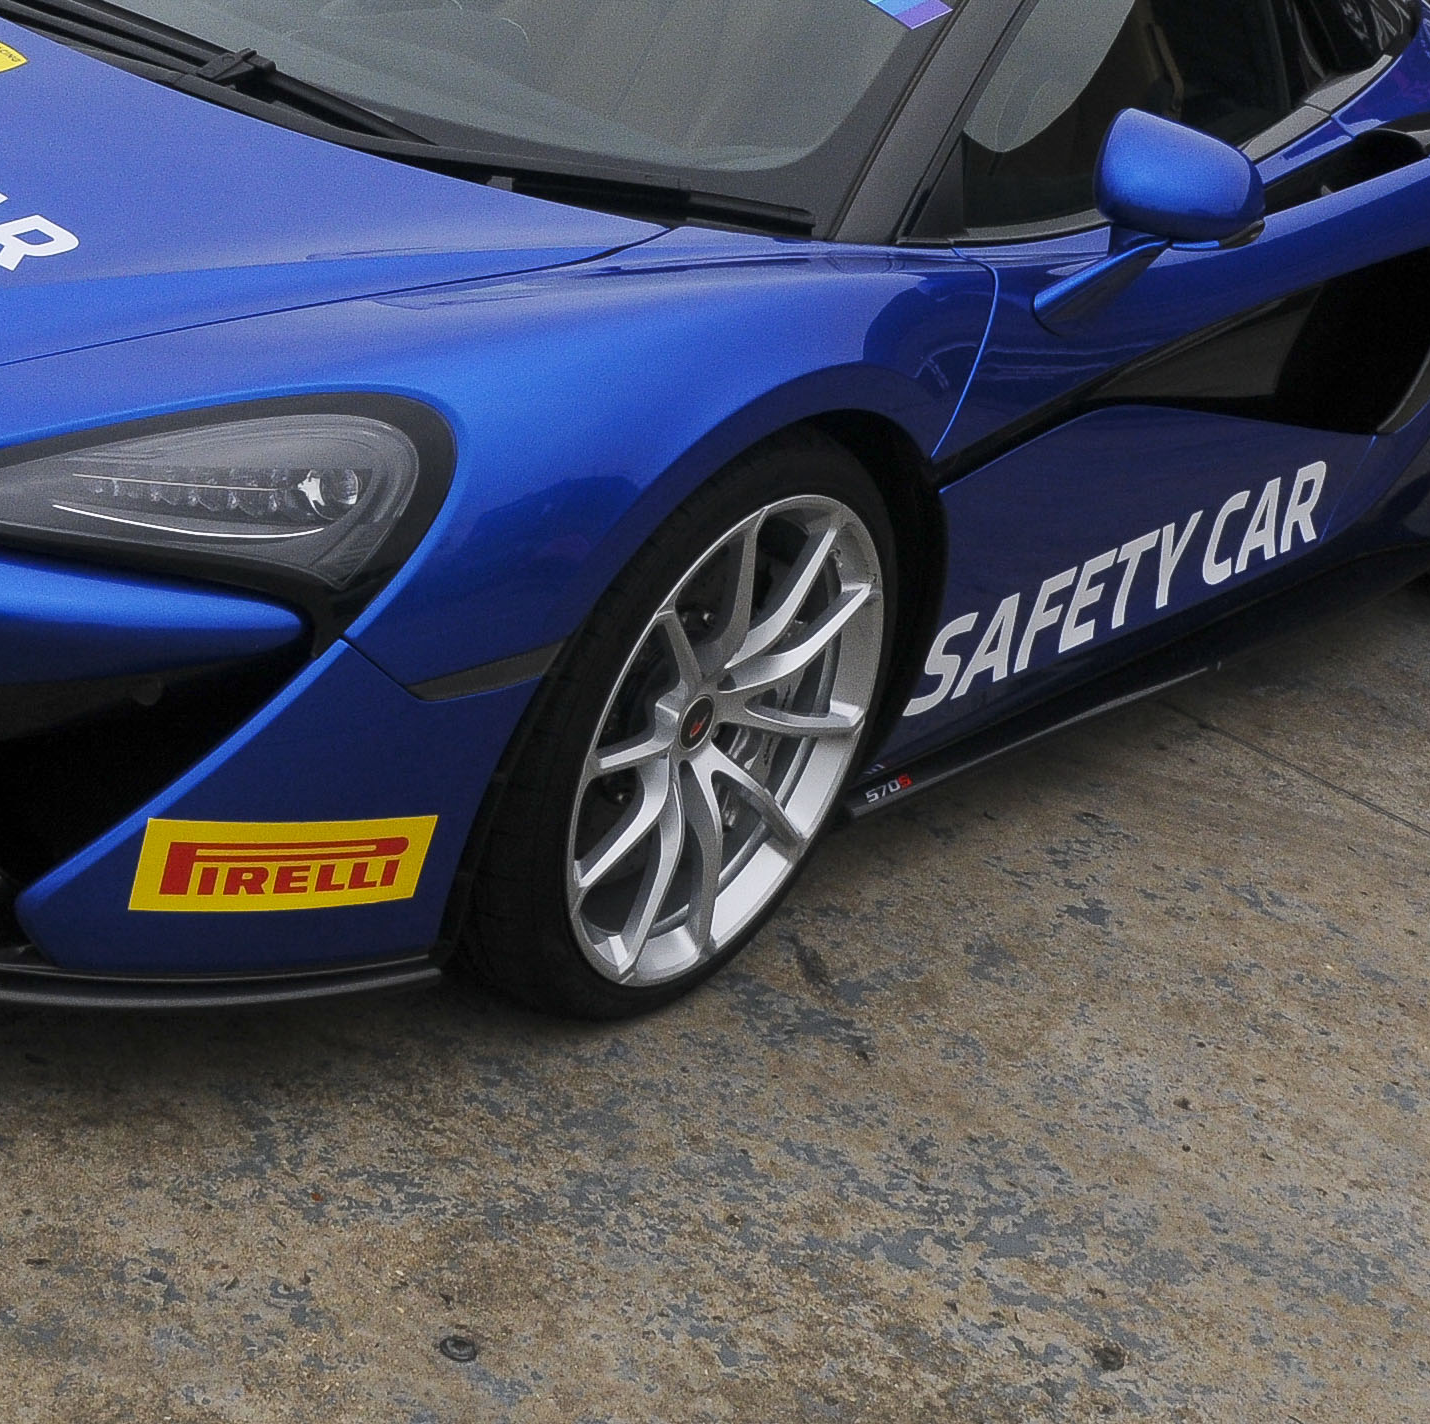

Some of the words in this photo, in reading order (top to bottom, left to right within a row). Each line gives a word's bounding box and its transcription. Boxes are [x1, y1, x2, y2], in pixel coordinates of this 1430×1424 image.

[902, 508, 1205, 718] SAFETY
[1201, 459, 1328, 586] CAR
[159, 836, 409, 896] PIRELLI
